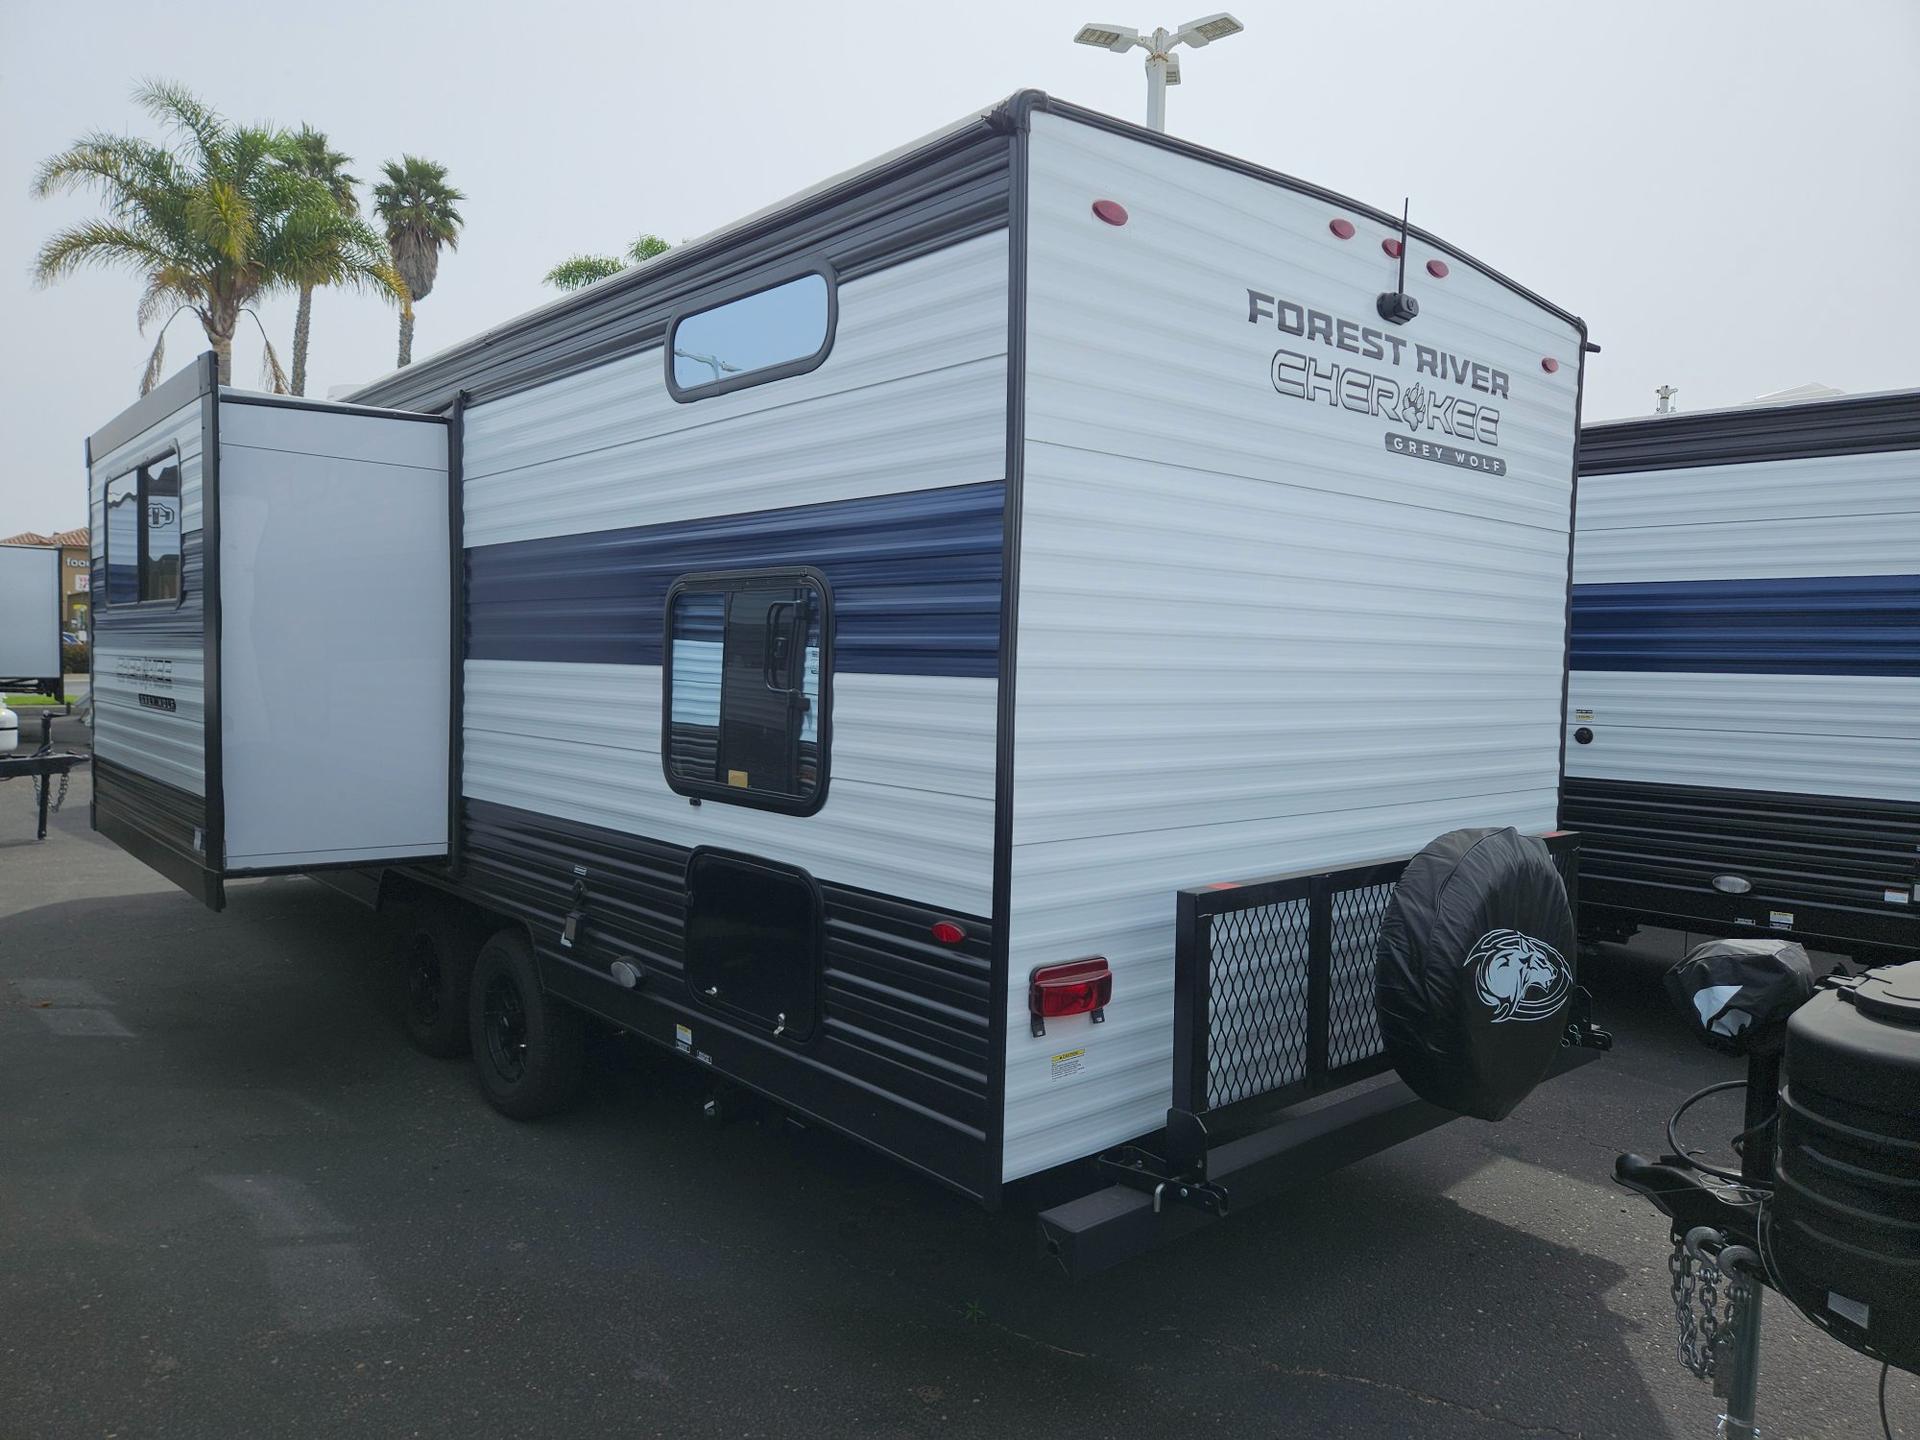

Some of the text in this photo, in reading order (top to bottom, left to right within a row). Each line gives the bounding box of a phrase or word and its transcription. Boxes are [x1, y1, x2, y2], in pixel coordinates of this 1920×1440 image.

[1247, 288, 1510, 400] FOREST RIVER
[1393, 437, 1501, 472] GREY WOLF
